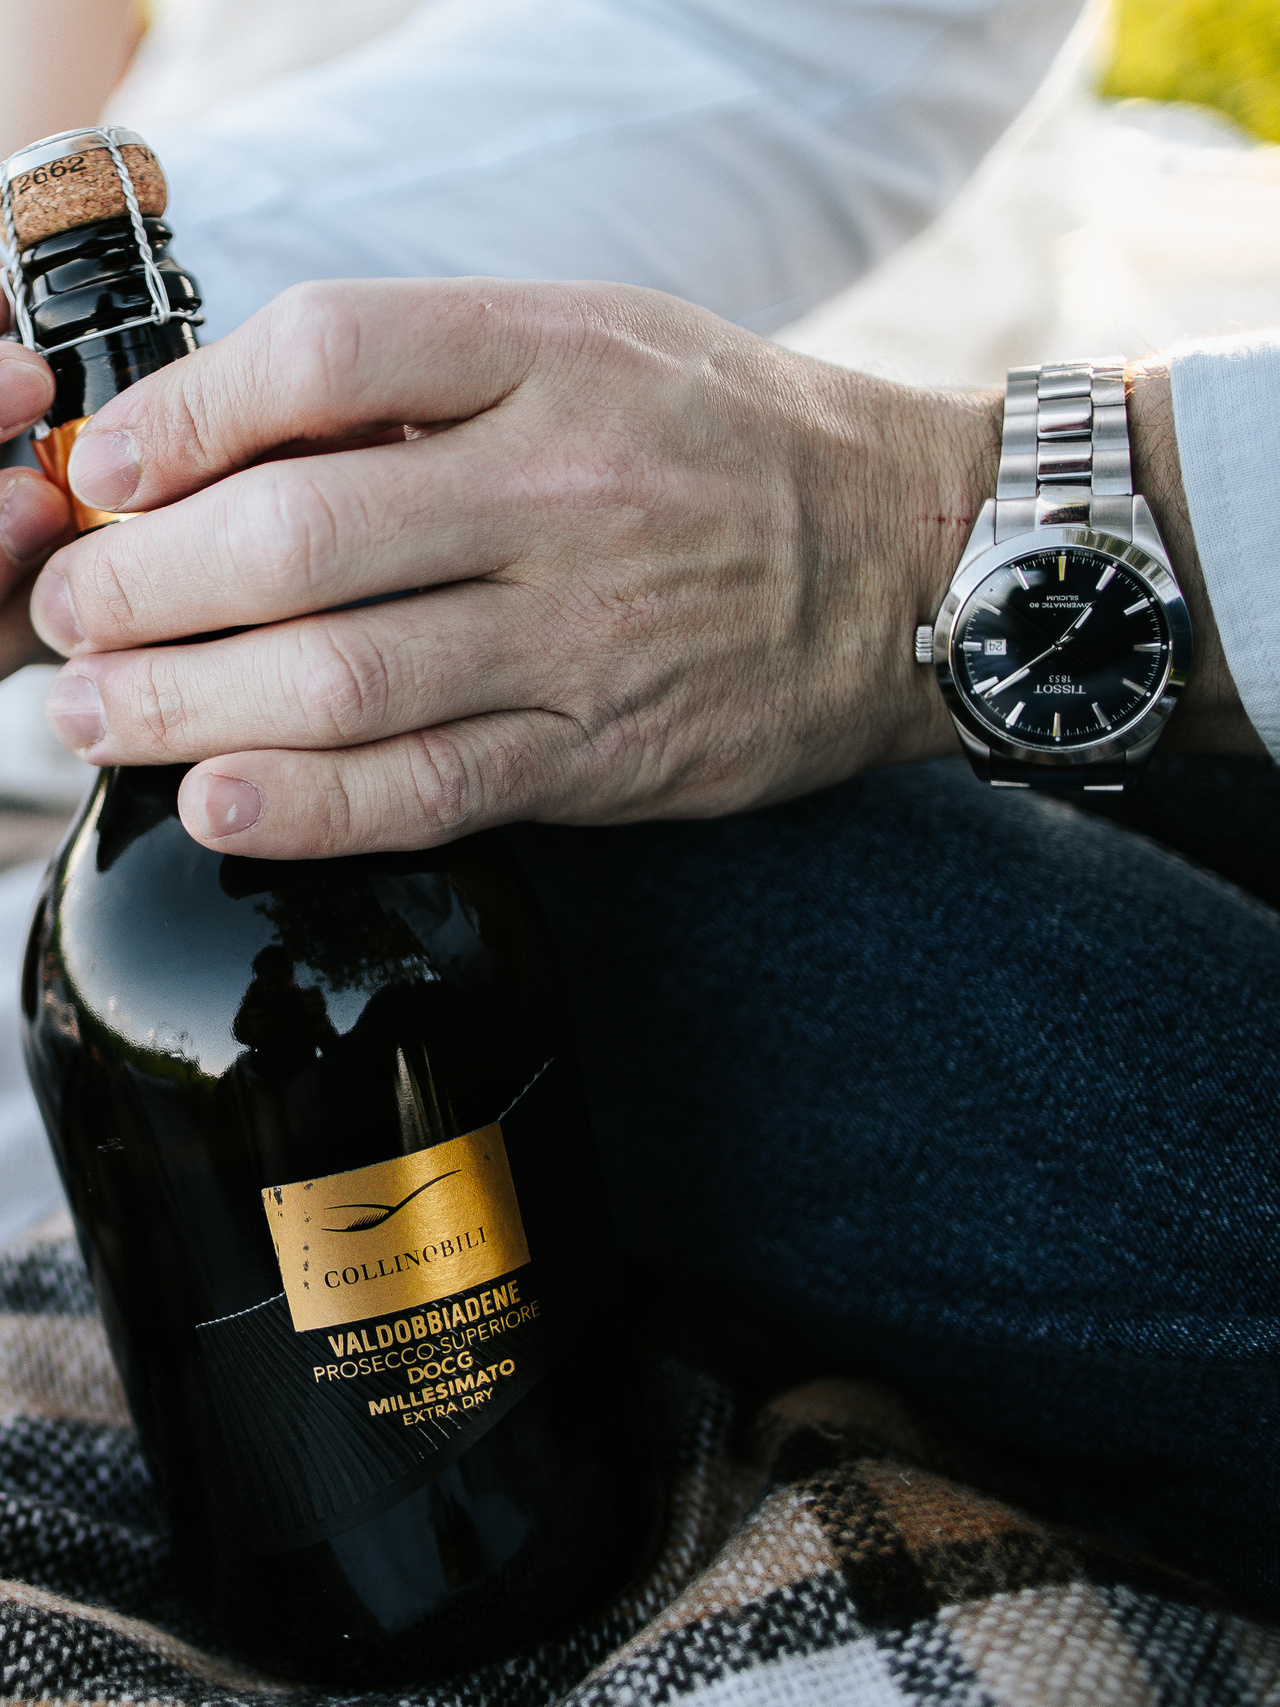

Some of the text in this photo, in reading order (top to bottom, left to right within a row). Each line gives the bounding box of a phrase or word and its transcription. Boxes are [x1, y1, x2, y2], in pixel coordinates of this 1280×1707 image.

[988, 641, 1003, 651] 24
[1033, 684, 1086, 694] TISSOT
[1048, 674, 1072, 683] 1853
[324, 1226, 487, 1289] COLLINOBILI
[328, 1279, 521, 1358] VALDOBBIADENE
[313, 1300, 541, 1383] PROSECCO SUPERIORE
[368, 1358, 516, 1416] MILLESIMATO
[407, 1351, 474, 1384] DOCG
[402, 1387, 494, 1426] EXTRA DRY
